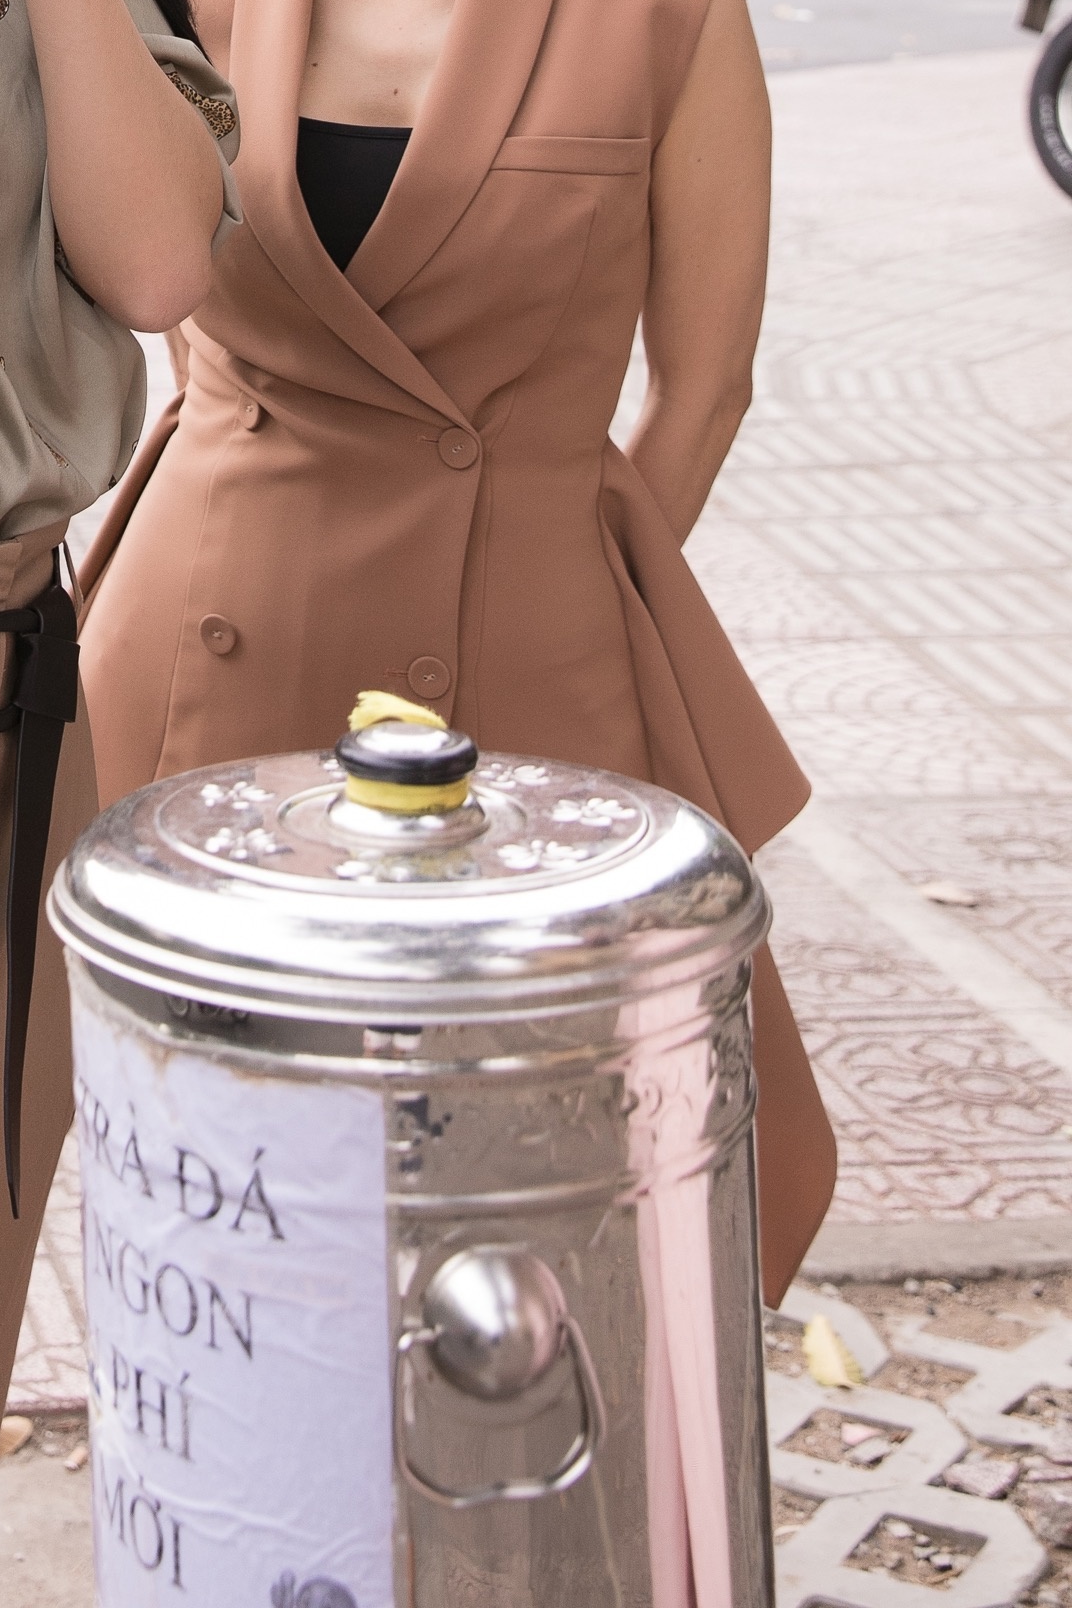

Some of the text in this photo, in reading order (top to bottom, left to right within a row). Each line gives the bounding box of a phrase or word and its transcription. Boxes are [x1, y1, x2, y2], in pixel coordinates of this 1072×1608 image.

[174, 1146, 286, 1241] ĐÁ
[91, 1206, 253, 1361] NGON
[111, 1342, 197, 1465] PHÍ
